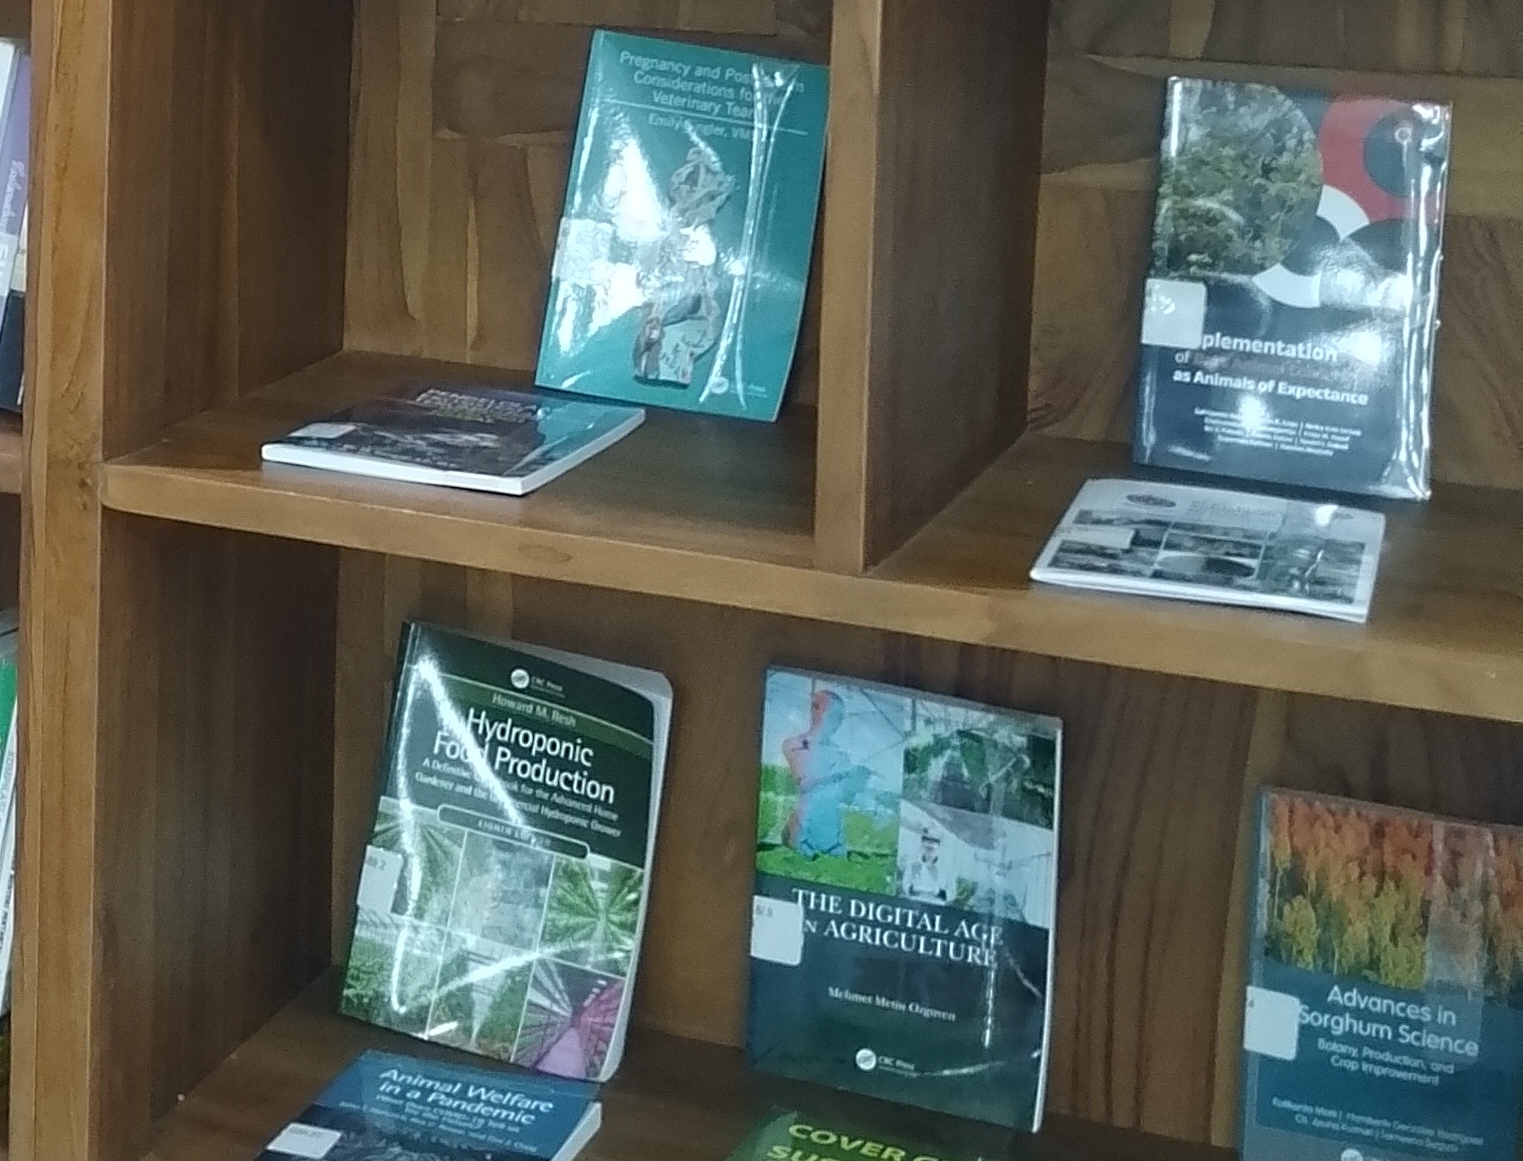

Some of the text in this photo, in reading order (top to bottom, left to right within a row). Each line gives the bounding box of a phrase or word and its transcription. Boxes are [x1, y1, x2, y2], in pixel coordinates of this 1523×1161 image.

[619, 50, 721, 79] Pregnancy and
[633, 69, 735, 100] Considerations
[651, 90, 722, 115] Veterinary
[1174, 350, 1191, 364] of
[1172, 369, 1369, 406] as Animals of Expectance
[492, 692, 534, 714] Howard
[551, 709, 577, 728] Resh
[467, 706, 595, 768] Hydroponic
[494, 745, 616, 805] Production
[792, 886, 1004, 946] THE DIGITAL AGE
[823, 919, 999, 967] AGRICULTURE
[828, 985, 873, 1005] Mehmet
[1327, 984, 1458, 1027] Advances in
[1298, 1003, 1479, 1057] Sorghum Science
[1317, 1037, 1455, 1075] Botany, Production, and
[1330, 1054, 1440, 1087] Crop Improvement
[378, 1068, 554, 1113] Animal Welfare
[379, 1081, 537, 1125] in a Pandemic
[788, 1123, 906, 1161] COVER
